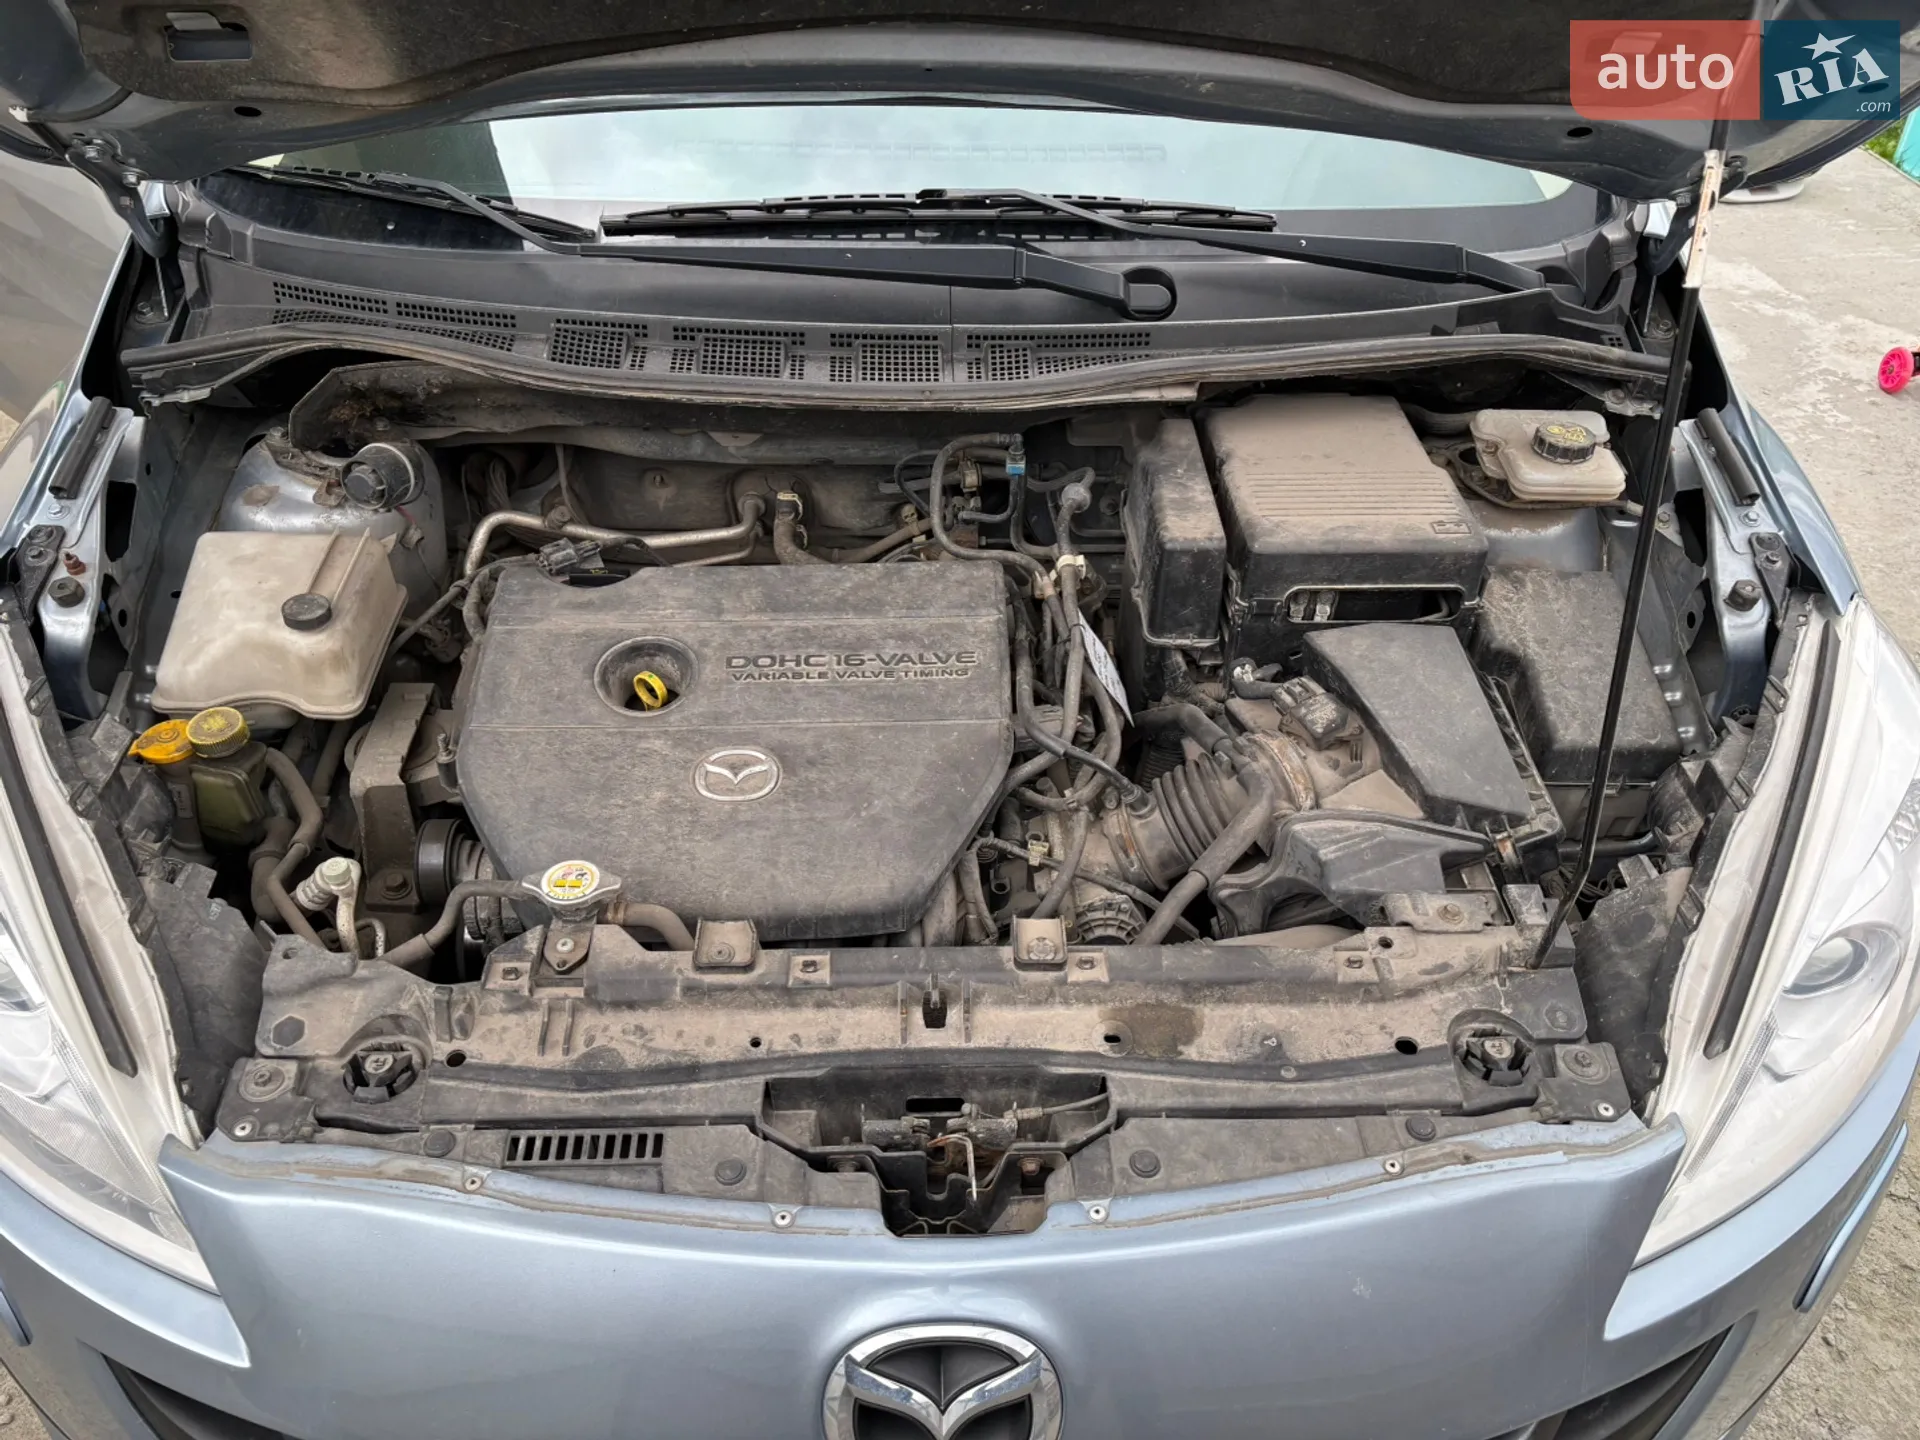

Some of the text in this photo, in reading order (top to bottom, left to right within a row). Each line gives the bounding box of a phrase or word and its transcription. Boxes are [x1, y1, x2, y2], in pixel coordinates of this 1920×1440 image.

[725, 651, 977, 670] DOHC 16-VALVE
[731, 668, 970, 681] VARIABLE VALVE TIMING
